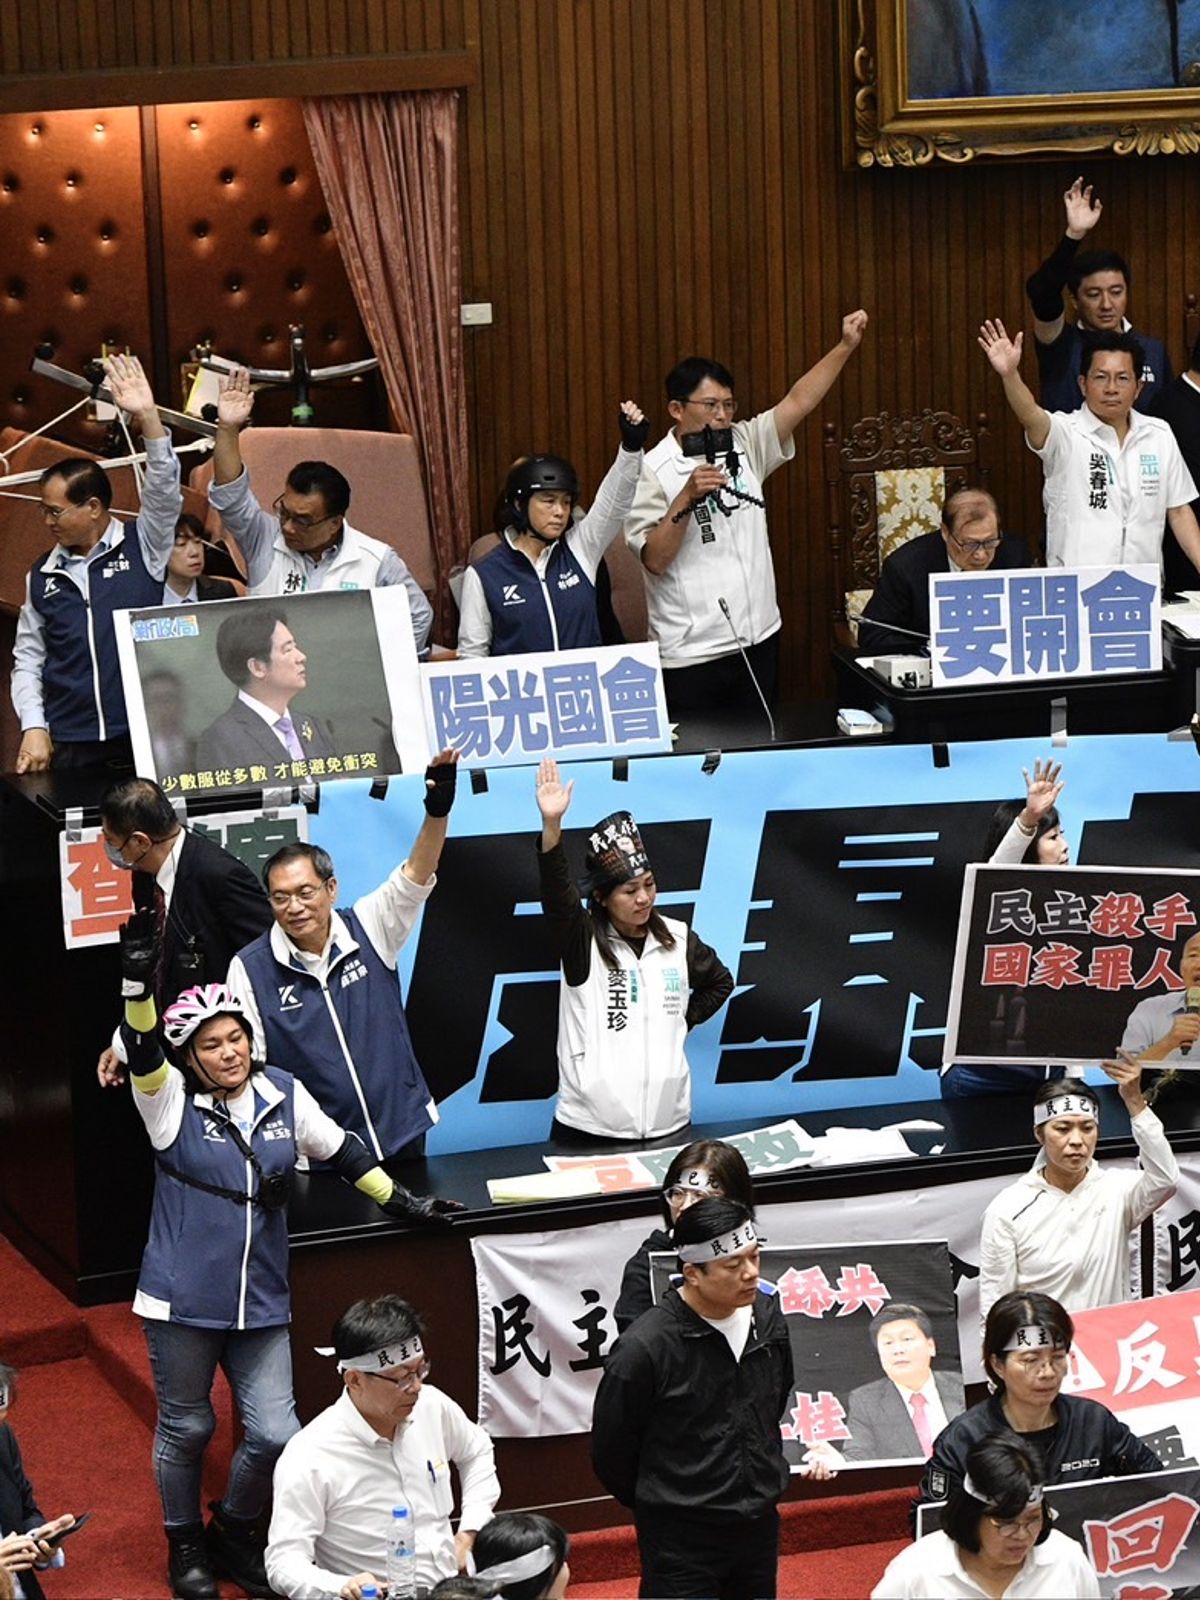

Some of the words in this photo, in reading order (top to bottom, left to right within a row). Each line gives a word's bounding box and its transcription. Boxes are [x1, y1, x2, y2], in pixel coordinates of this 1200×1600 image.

[1089, 453, 1108, 510] 吳春城
[933, 569, 1158, 680] 要開會
[429, 655, 662, 759] 陽光國會
[161, 765, 268, 793] 少數服從多數
[273, 752, 378, 780] 才能避免衝突
[986, 888, 1198, 941] 民主殺手
[981, 941, 1186, 991] 國家罪人
[607, 968, 628, 1032] 麥玉珍
[1045, 1097, 1096, 1117] 民主已
[490, 1288, 611, 1378] 民主
